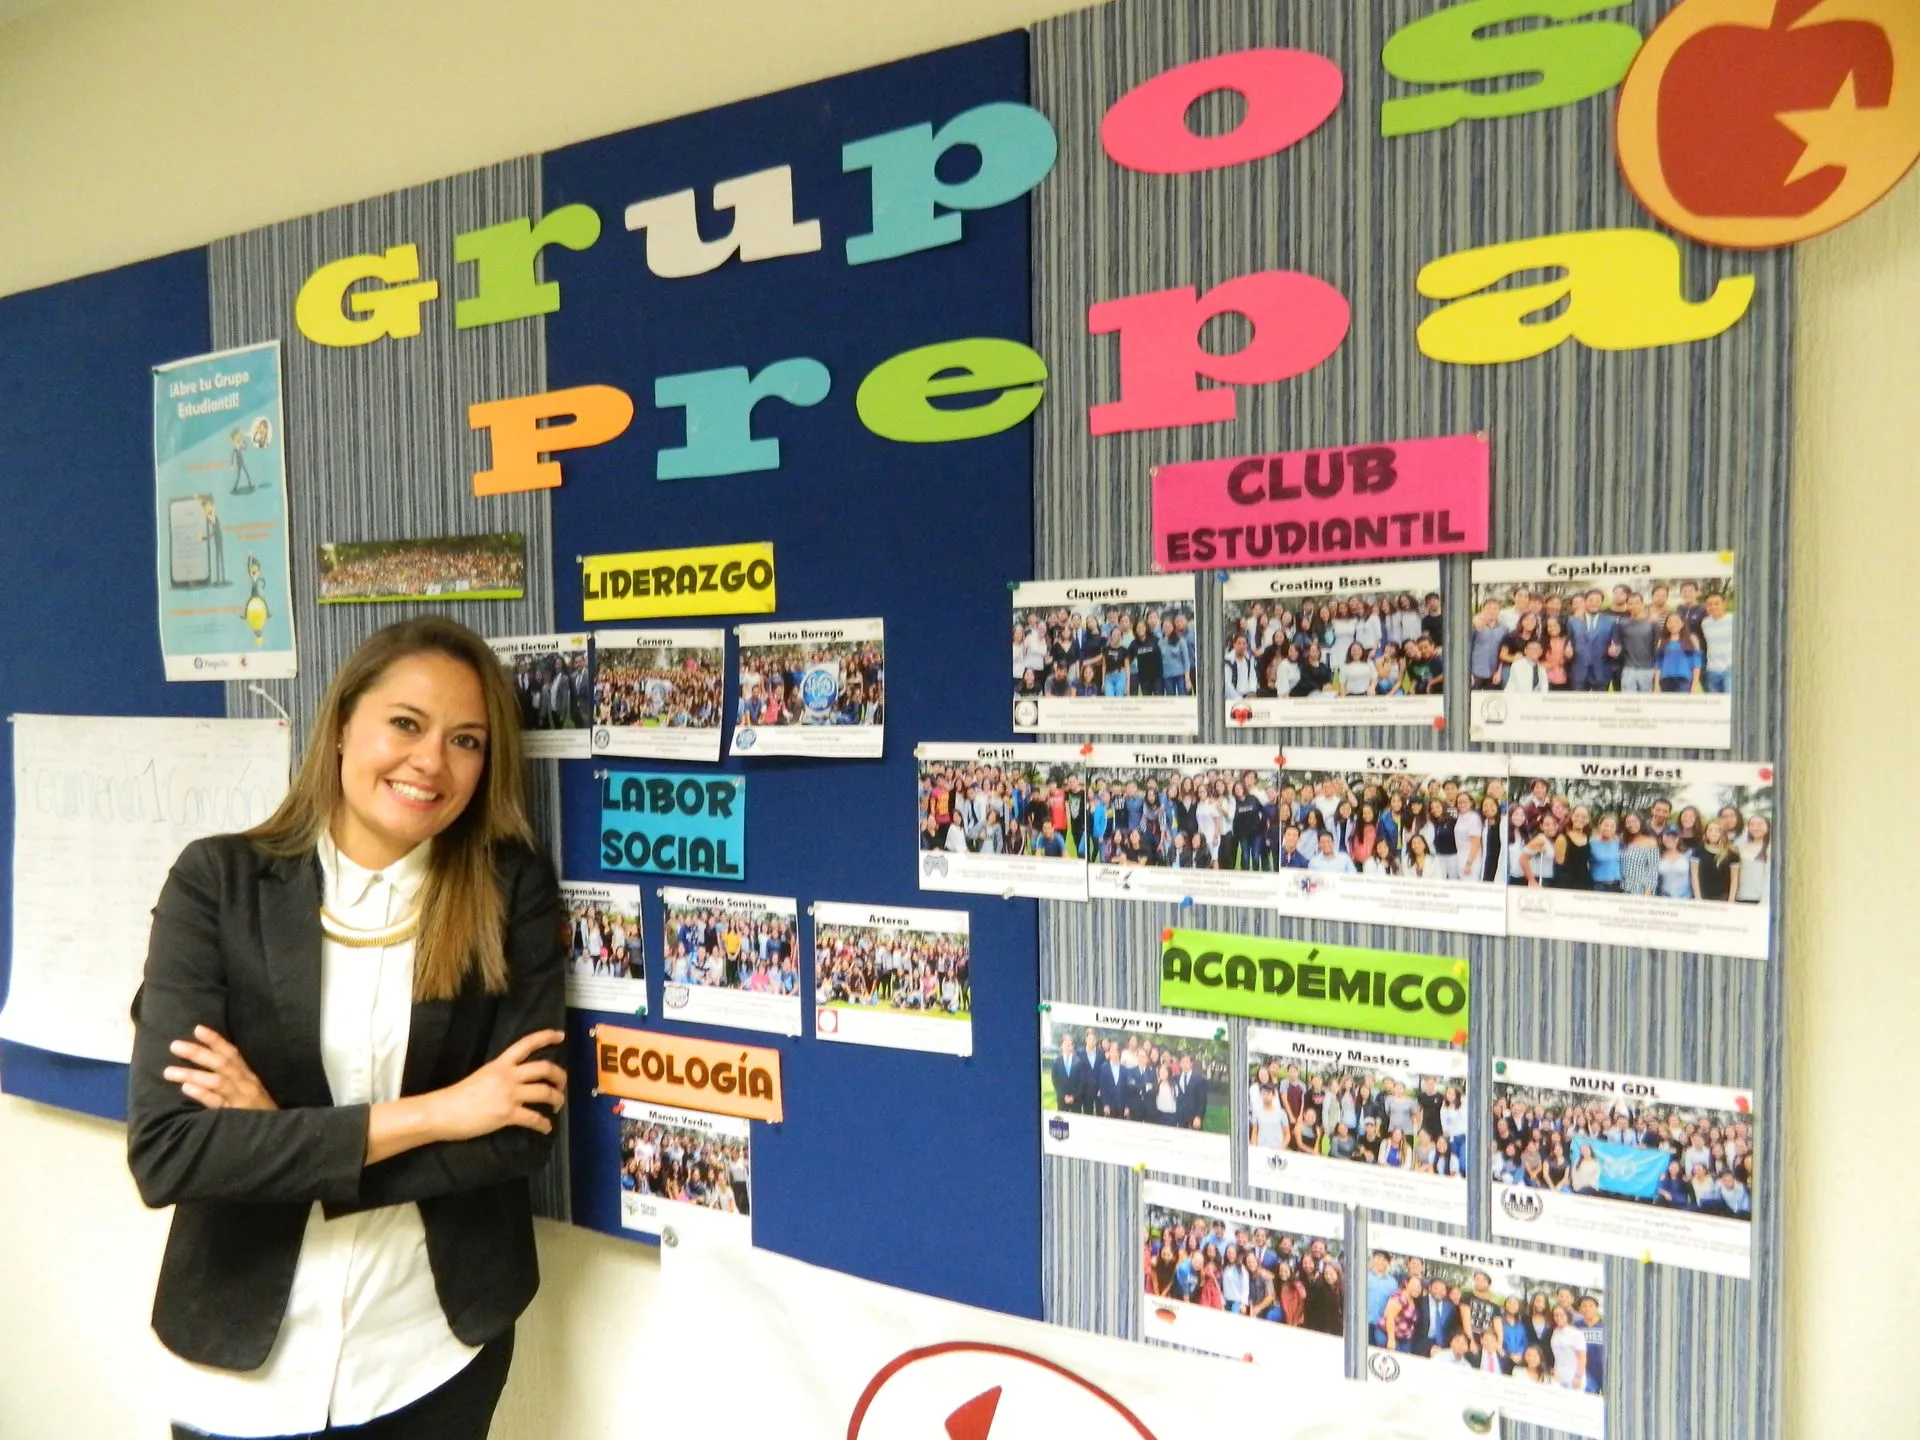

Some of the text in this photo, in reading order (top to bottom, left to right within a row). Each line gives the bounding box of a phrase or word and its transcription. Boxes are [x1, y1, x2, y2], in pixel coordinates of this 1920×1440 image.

[296, 0, 1644, 347] Grupos
[200, 378, 212, 391] tu
[214, 372, 250, 388] Grupo
[1227, 446, 1398, 505] CLUB
[1166, 510, 1465, 563] ESTUDIANTIL
[584, 558, 774, 600] LIDERAZGO
[1547, 562, 1651, 577] Capablanca
[1270, 574, 1382, 594] Creating Beats
[1066, 587, 1128, 601] Claquette
[636, 637, 673, 647] Carnero
[769, 627, 844, 641] Harto Borrego
[521, 640, 559, 652] Electoral
[977, 748, 998, 759] Got
[1134, 753, 1218, 765] Tinta Blanca
[1581, 763, 1683, 779] World Fest
[143, 757, 168, 823] 1
[602, 774, 736, 818] LABOR
[602, 830, 739, 874] SOCIAL
[559, 887, 610, 897] angemakers
[686, 894, 767, 910] Creando Sonrisas
[1162, 948, 1466, 1015] ACADÉMICO
[1095, 1013, 1164, 1032] Lawyer up
[1292, 1042, 1411, 1068] Money Masters
[600, 1043, 773, 1101] ECOLOGÍA
[1570, 1076, 1659, 1098] MUN GDL
[649, 1110, 713, 1129] Manos Verdes
[1440, 1246, 1516, 1270] ExpresaT
